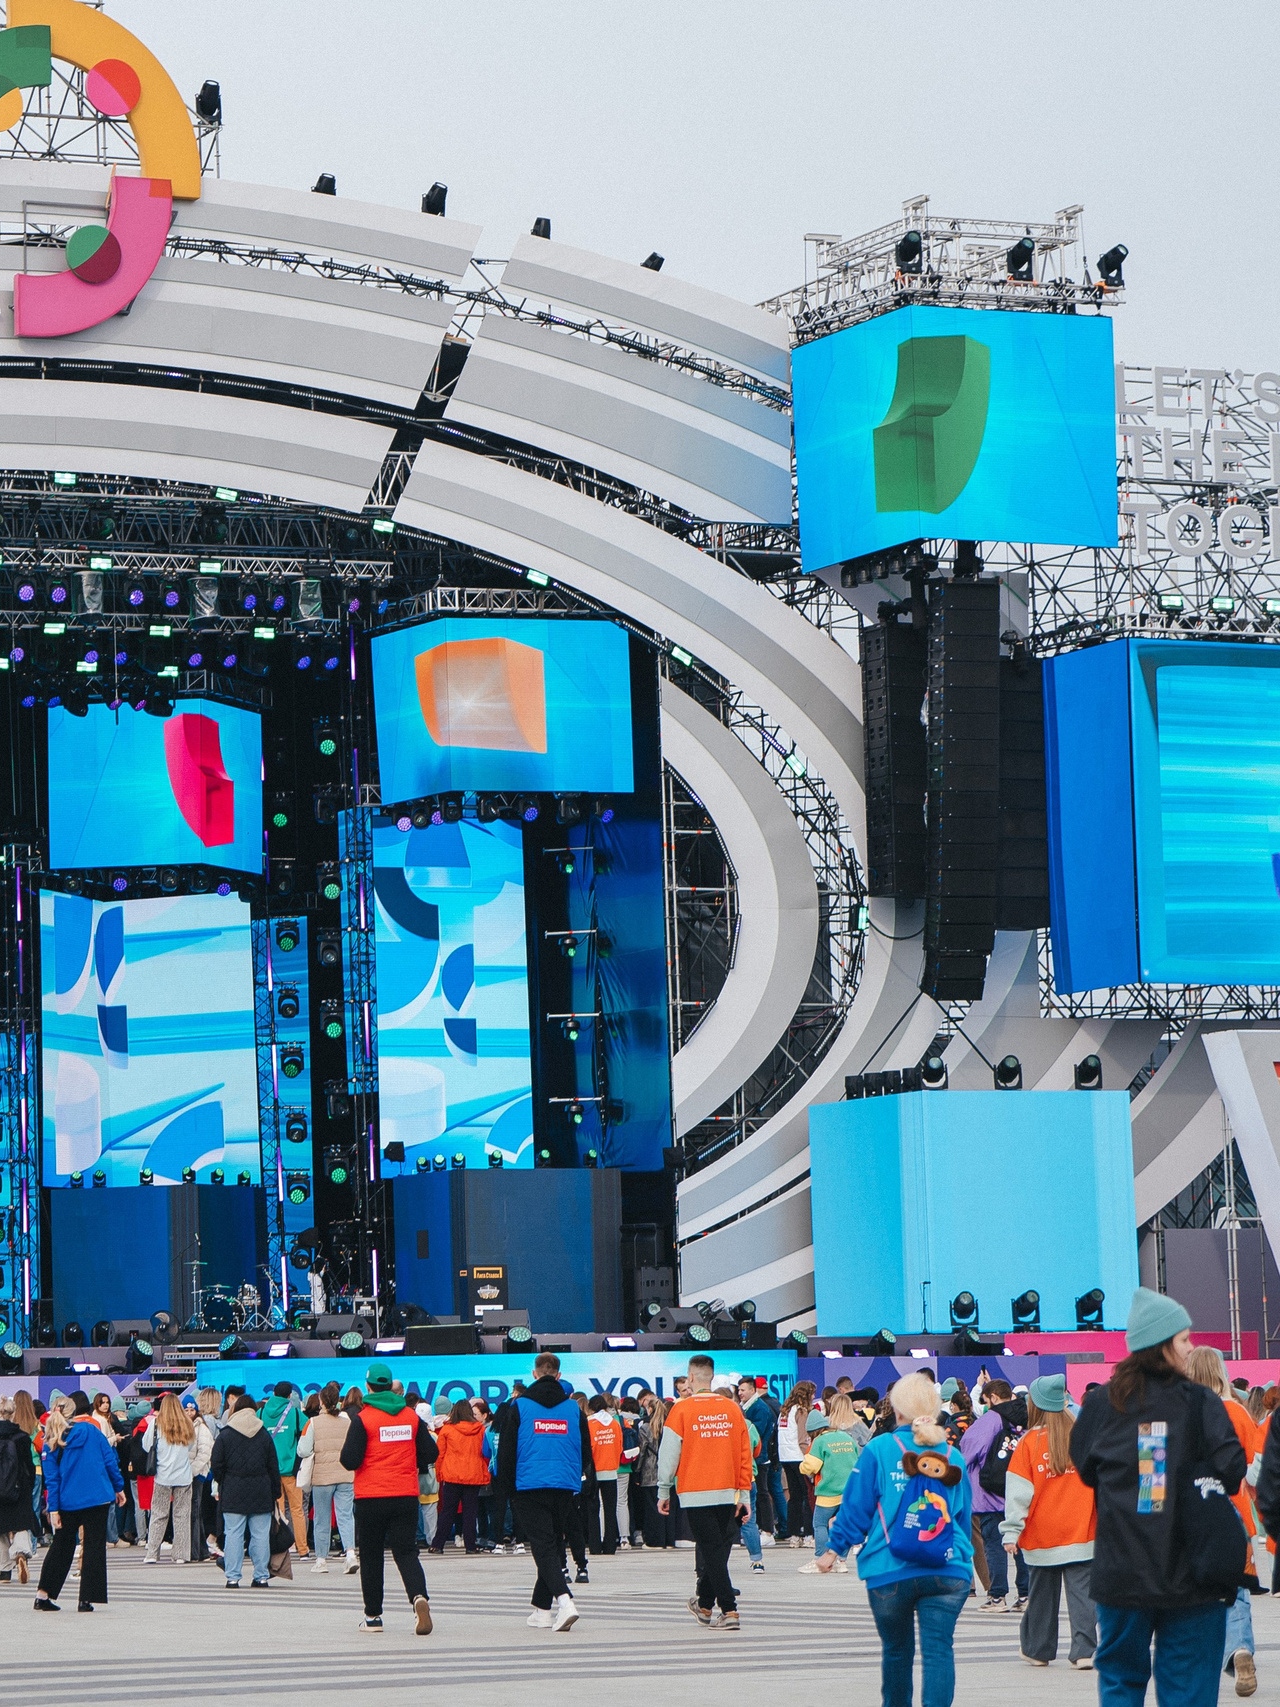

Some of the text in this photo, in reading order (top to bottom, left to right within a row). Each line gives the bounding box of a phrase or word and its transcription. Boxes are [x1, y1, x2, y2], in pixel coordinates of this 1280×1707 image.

[1117, 423, 1247, 484] THE
[697, 1413, 728, 1422] СМЫСЛ
[534, 1421, 567, 1431] Первые
[381, 1429, 411, 1438] Первые
[712, 1430, 729, 1438] НАС
